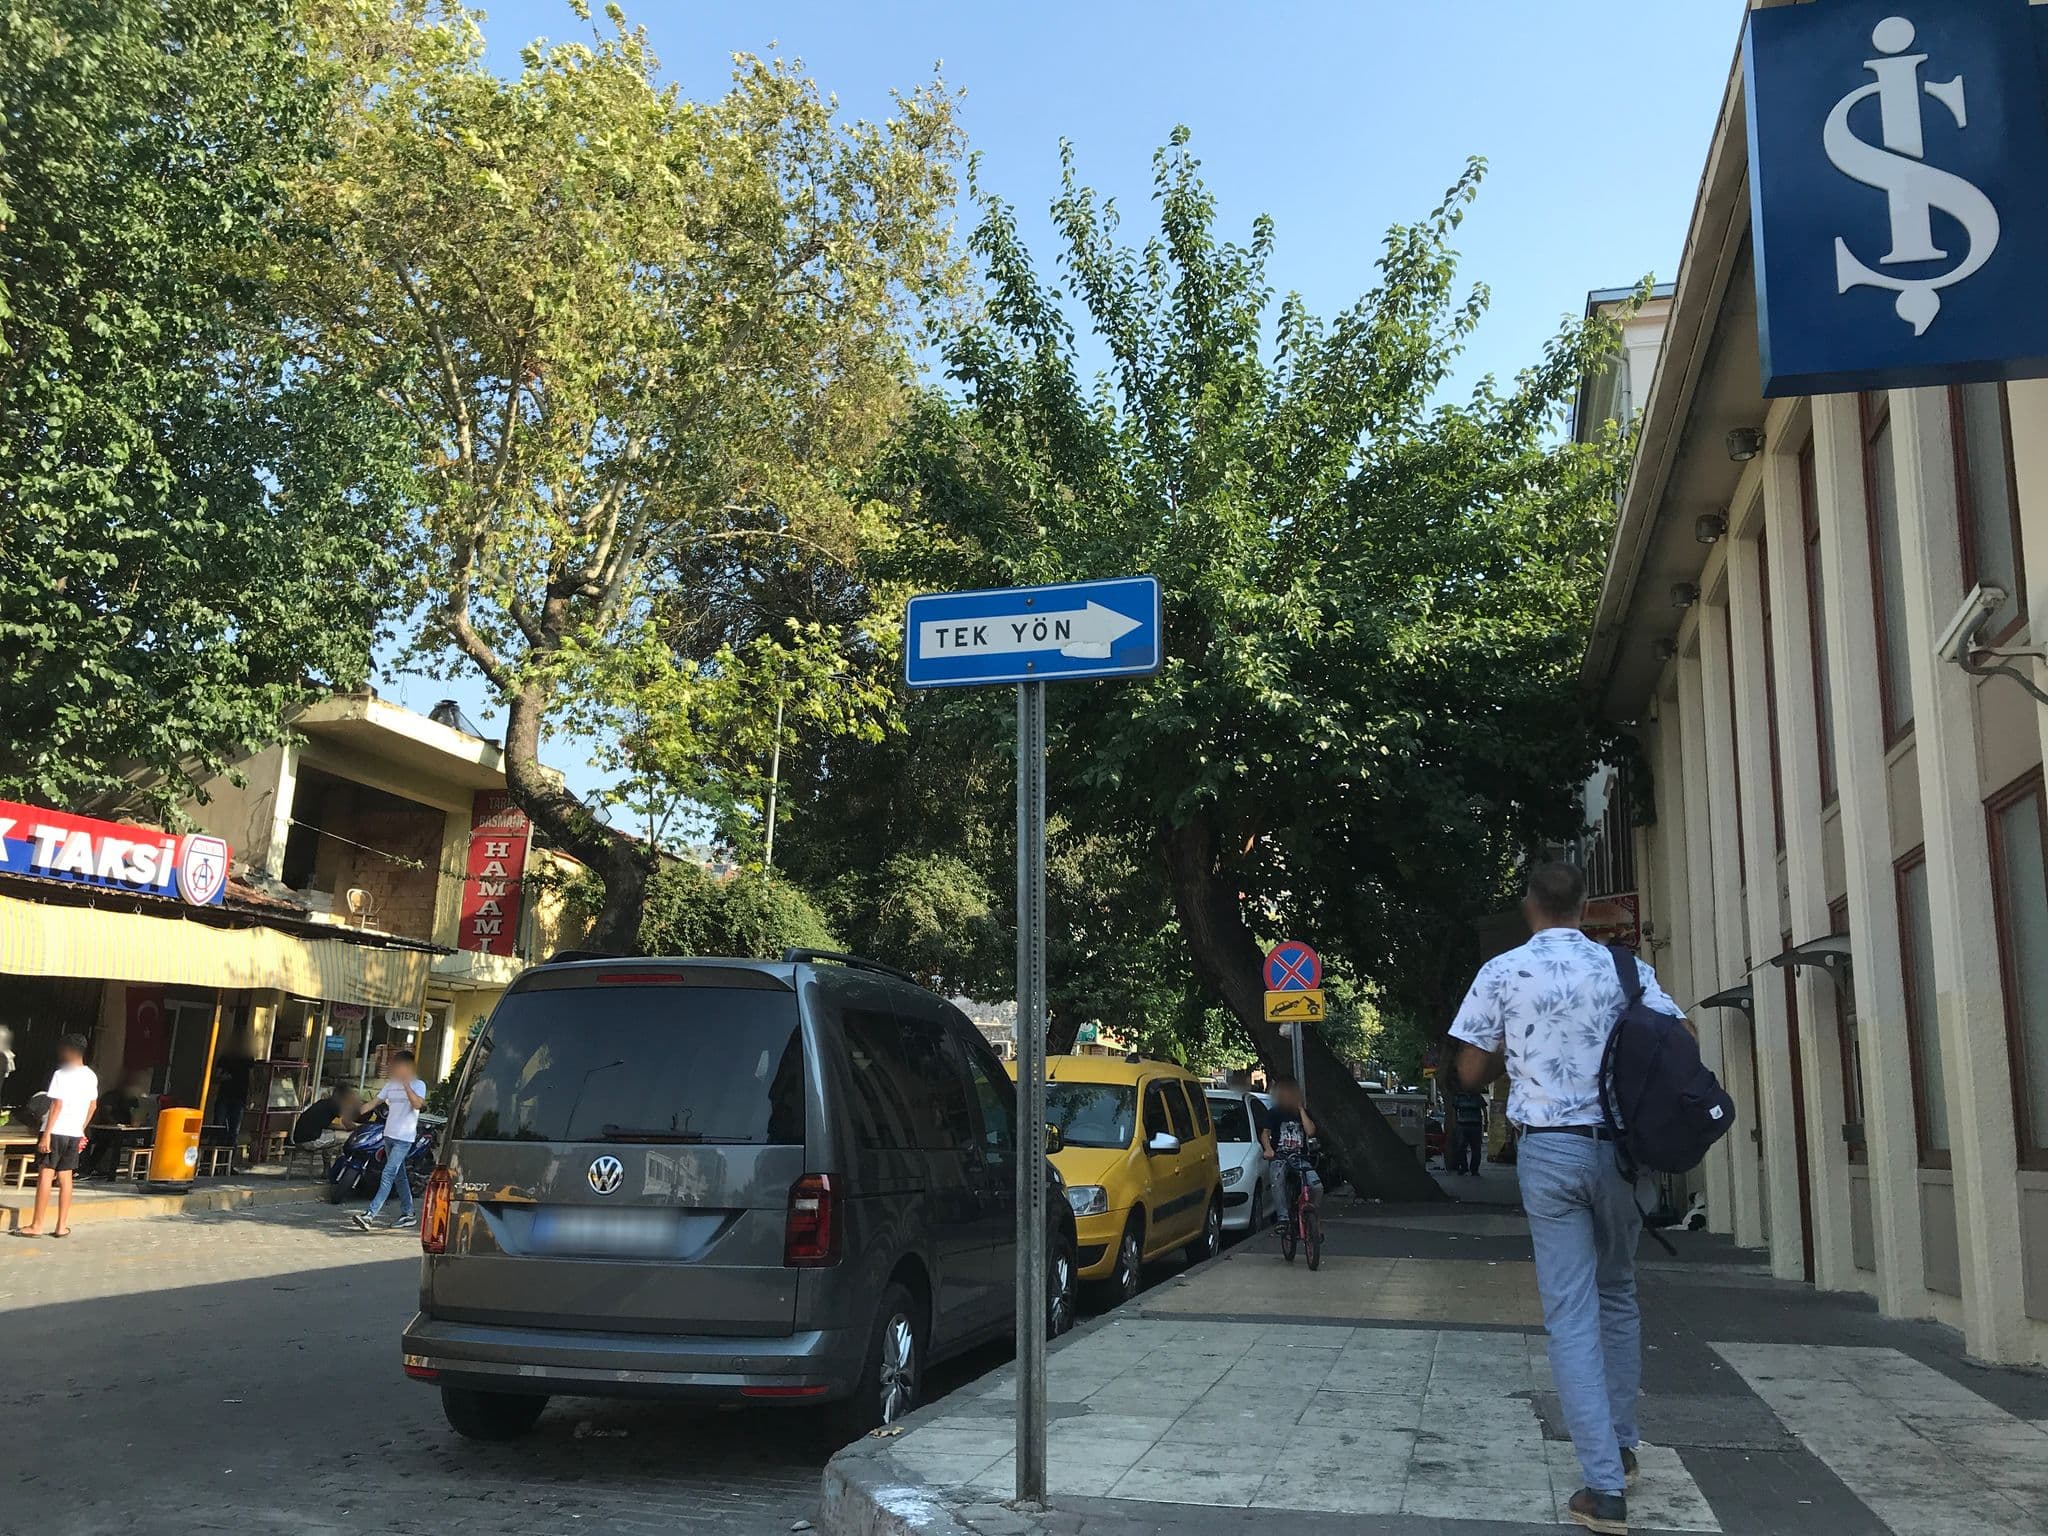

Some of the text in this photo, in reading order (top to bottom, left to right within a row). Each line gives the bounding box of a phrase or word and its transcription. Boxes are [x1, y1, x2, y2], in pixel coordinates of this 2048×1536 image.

[935, 617, 1071, 649] TEK YÖN
[479, 814, 526, 828] BASMANE
